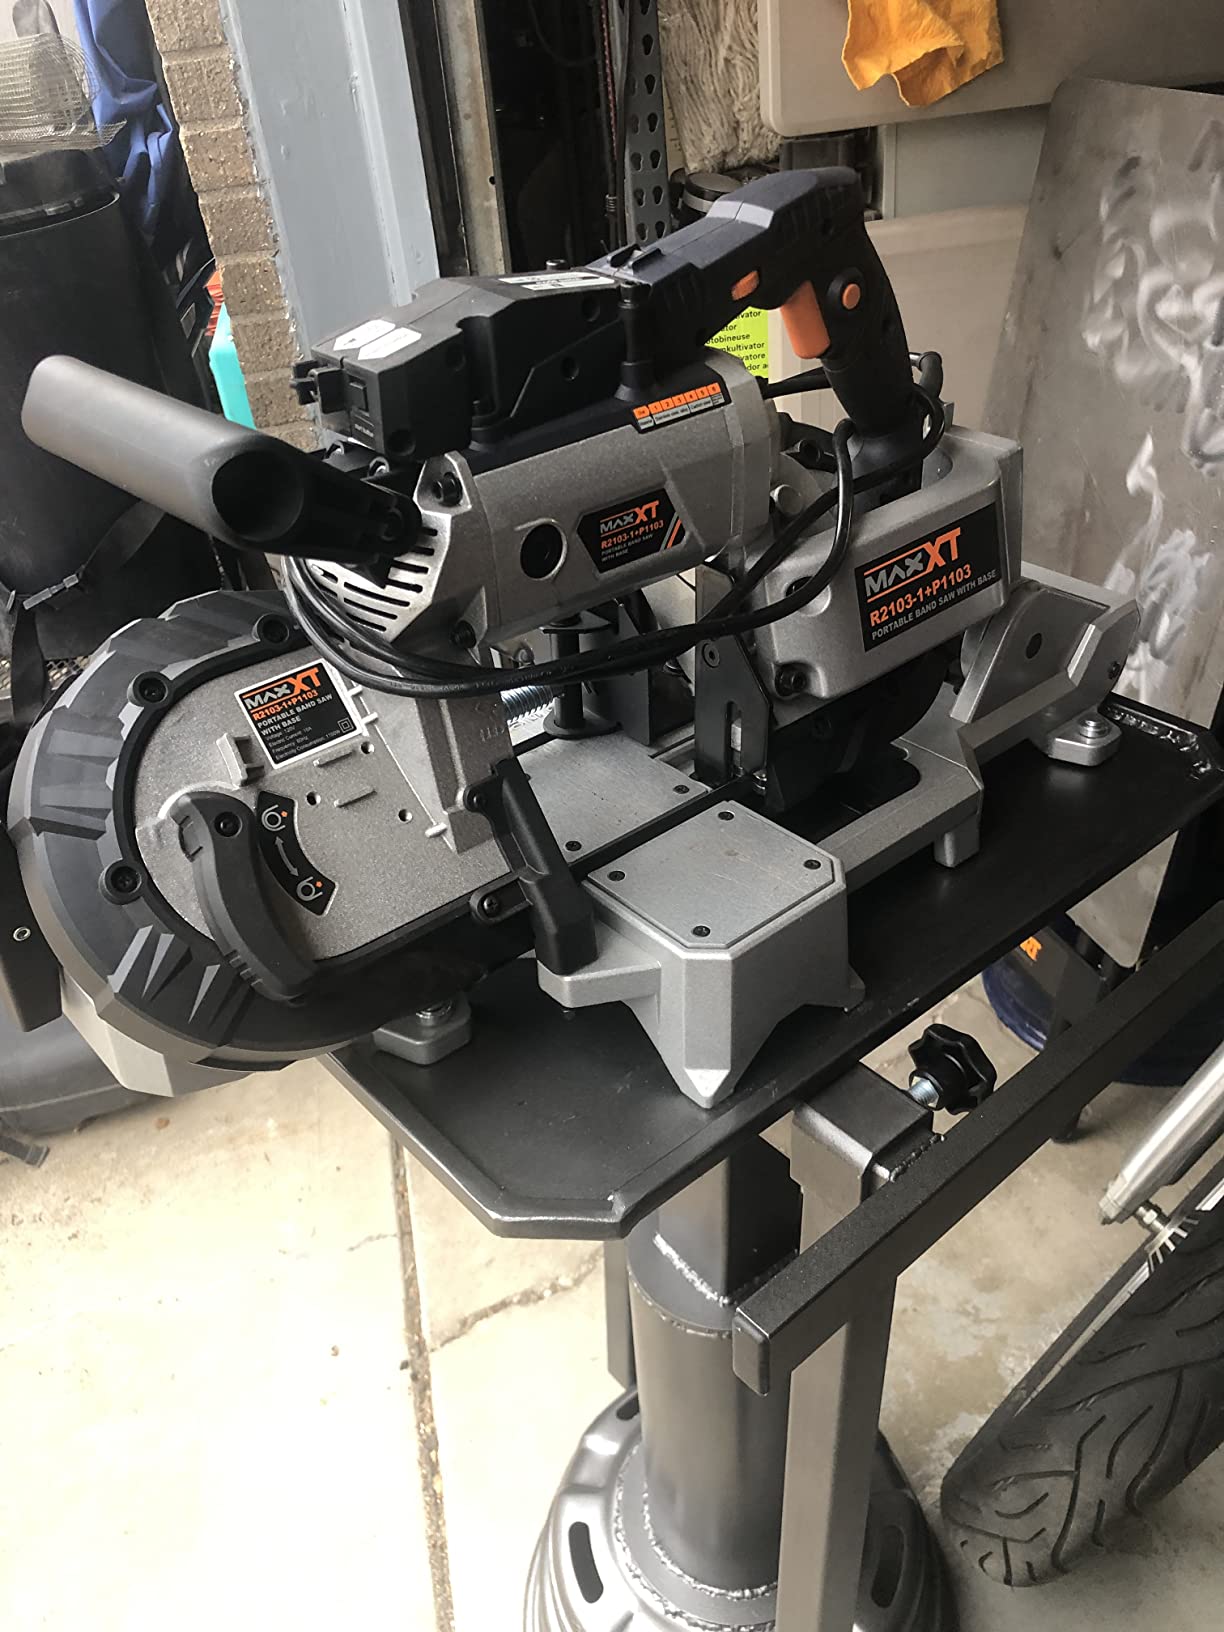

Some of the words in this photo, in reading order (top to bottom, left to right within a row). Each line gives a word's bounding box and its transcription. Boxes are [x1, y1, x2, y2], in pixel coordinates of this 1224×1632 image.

[746, 363, 760, 371] dor
[600, 500, 659, 533] MAXXT
[601, 520, 664, 549] R2103-1+P1103
[864, 527, 960, 597] MAXXT
[870, 563, 972, 627] R2103-1+P1103
[871, 612, 913, 640] PORTABLE
[915, 601, 937, 618] BAND
[938, 591, 955, 606] SAW
[957, 581, 976, 596] WITH
[977, 569, 997, 586] BASE
[243, 667, 321, 710] MAXXT
[252, 690, 318, 720] R2103-1+P1103
[257, 709, 295, 729] PORTABLE
[296, 699, 316, 712] BAND
[317, 694, 333, 705] SAW
[261, 722, 281, 736] WITH
[282, 716, 301, 728] BASE
